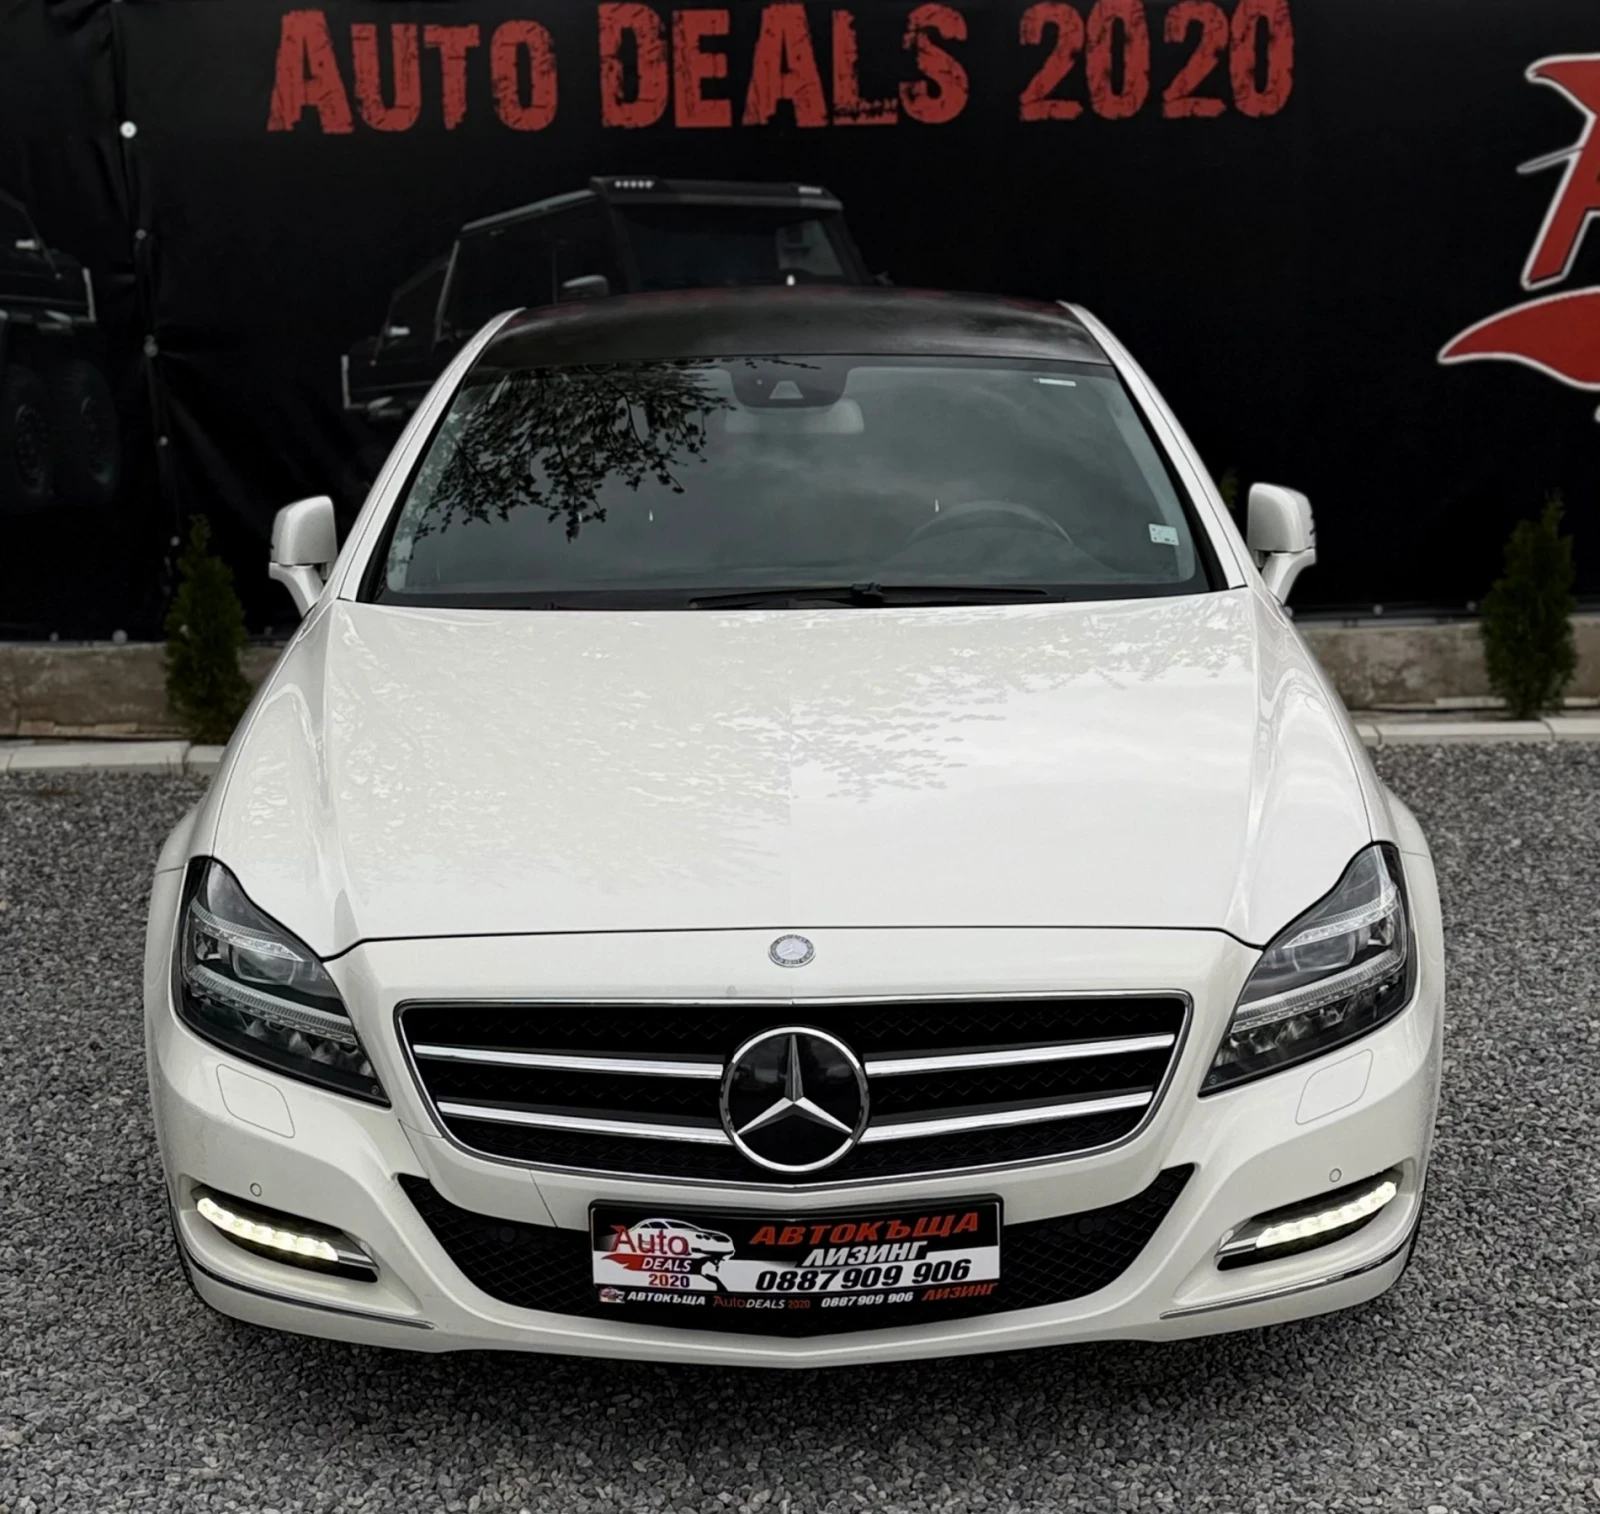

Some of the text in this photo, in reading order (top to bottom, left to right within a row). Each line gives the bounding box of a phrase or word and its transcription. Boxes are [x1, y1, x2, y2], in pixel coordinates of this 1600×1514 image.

[269, 0, 1293, 132] AUTO DEALS 2020
[749, 1212, 979, 1245] АВТОКЪЩА
[610, 1225, 692, 1256] Auto
[802, 1241, 928, 1267] ЛИЗИНГ
[641, 1257, 692, 1272] DEALS
[911, 1259, 972, 1284] 906
[648, 1274, 690, 1288] 2020
[627, 1291, 706, 1305] АВТОКЪЩА
[887, 1292, 914, 1304] 906
[921, 1283, 999, 1301] ЛИЗИНГ
[788, 1300, 811, 1309] 2020
